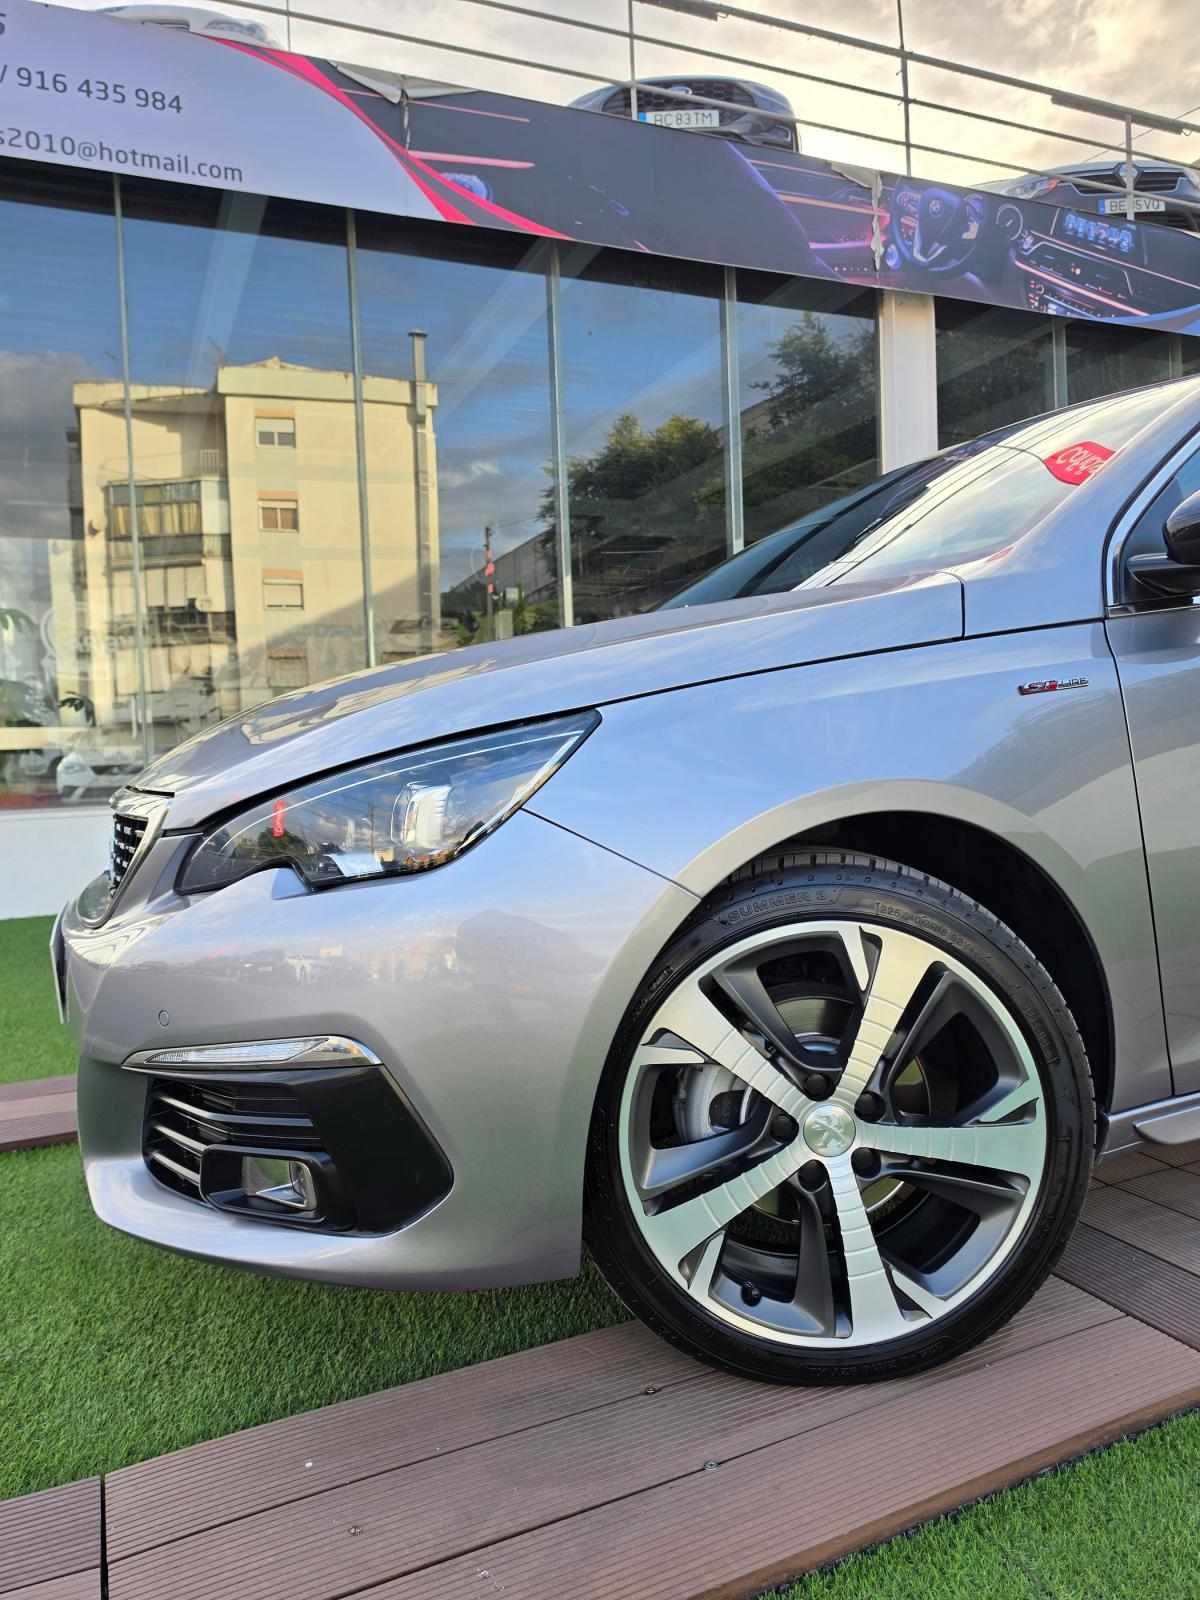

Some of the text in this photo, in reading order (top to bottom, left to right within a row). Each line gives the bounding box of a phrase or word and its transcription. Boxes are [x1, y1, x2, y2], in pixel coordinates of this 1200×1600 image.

[16, 67, 68, 94] 916
[77, 79, 126, 104] 435
[135, 88, 183, 114] 984
